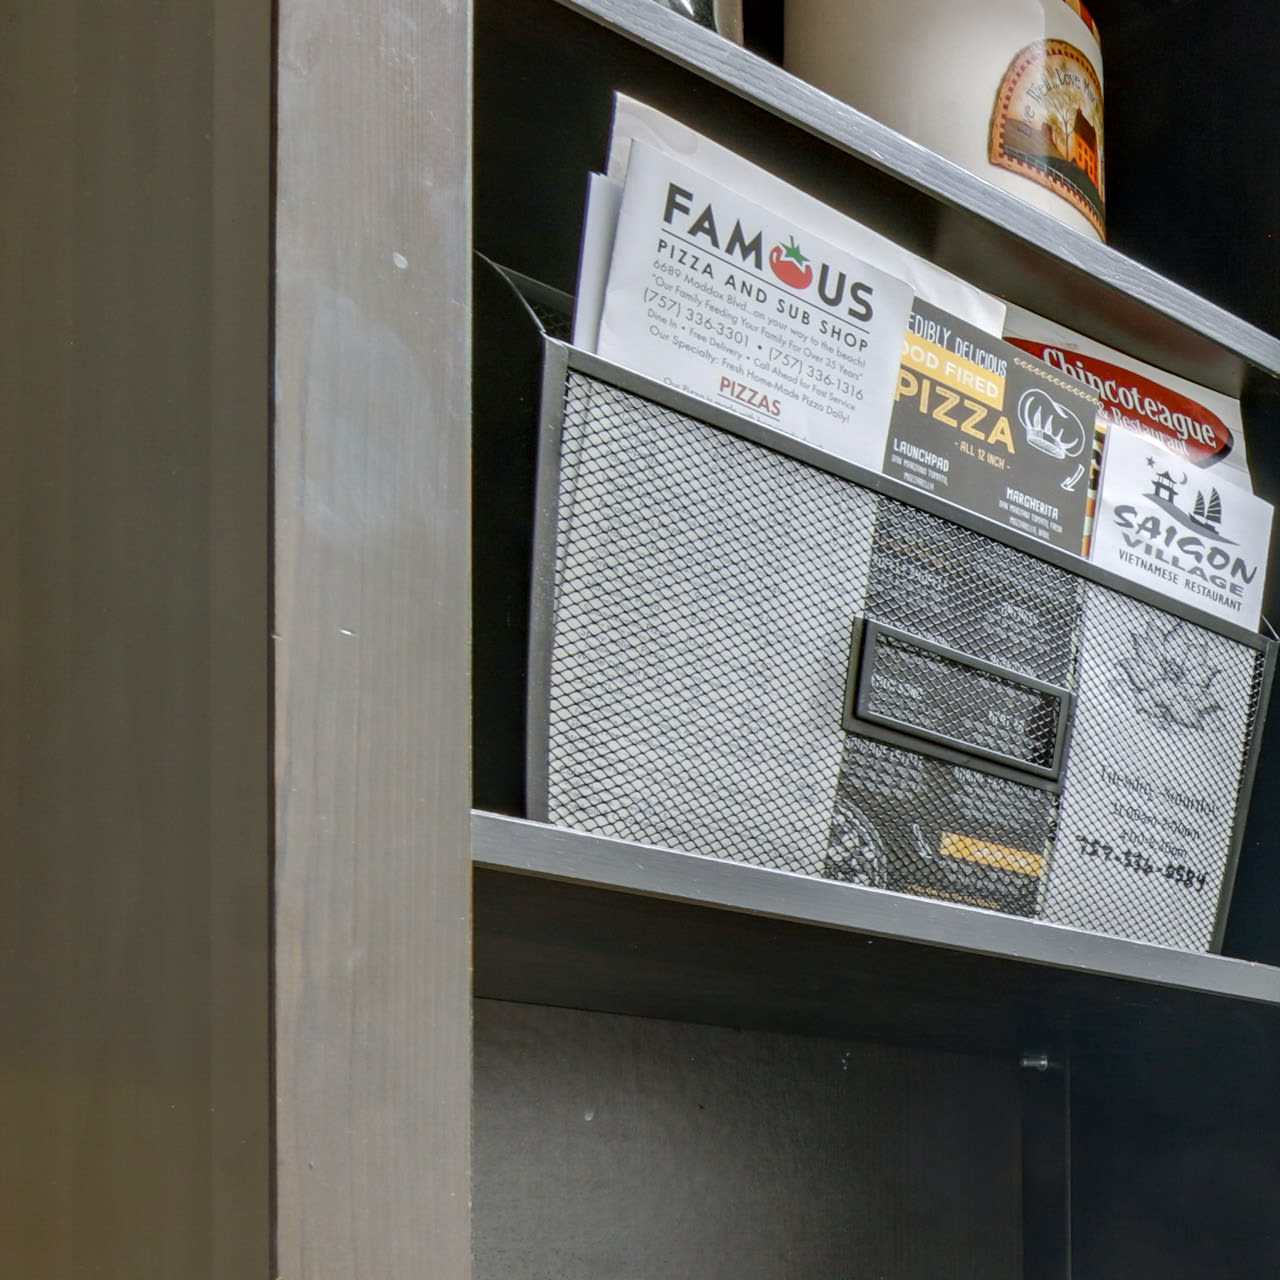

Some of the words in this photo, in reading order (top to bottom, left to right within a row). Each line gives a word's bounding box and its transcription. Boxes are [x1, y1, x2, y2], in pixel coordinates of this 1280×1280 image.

[643, 287, 681, 318] (757)
[684, 307, 750, 348] 336-3301
[652, 260, 682, 278] 6689
[683, 273, 724, 300] Maddox
[767, 316, 788, 333] your
[790, 327, 809, 343] way
[810, 335, 819, 346] to
[820, 340, 835, 354] the
[657, 239, 714, 280] PIZZA
[724, 274, 767, 304] AND
[776, 298, 811, 326] SUB
[819, 319, 869, 352] SHOP
[674, 284, 702, 308] Family
[704, 299, 738, 326] Feeding
[740, 315, 758, 332] Your
[761, 327, 787, 347] Family
[803, 346, 823, 363] Over
[825, 356, 837, 370] 35
[649, 324, 670, 341] Our
[720, 356, 745, 376] Fresh
[746, 368, 800, 400] Home-Made
[801, 393, 825, 412] Pizza
[689, 327, 708, 343] Free
[709, 336, 743, 361] Delivery
[811, 384, 828, 399] Fast
[828, 391, 857, 412] Service
[768, 346, 803, 375] (757)
[806, 365, 864, 401] 336-1316
[901, 341, 940, 370] OD
[944, 360, 1000, 399] FIRED
[955, 336, 1008, 378] DELICIOUS
[719, 375, 782, 418] PIZZAS
[895, 367, 1016, 455] PIZZA
[1042, 347, 1217, 449] Chincoteague
[893, 437, 950, 473] LAUNCHPAD
[960, 440, 976, 457] ALL
[977, 448, 986, 462] 12
[986, 453, 1006, 470] INCH
[1112, 405, 1190, 457] Restaurant
[1006, 487, 1060, 521] MARGHERITA
[1113, 504, 1258, 585] SAIGON
[1121, 531, 1246, 599] VILLAGE
[1119, 548, 1180, 585] VIETNAMESE
[1184, 580, 1243, 613] RESTAURANT
